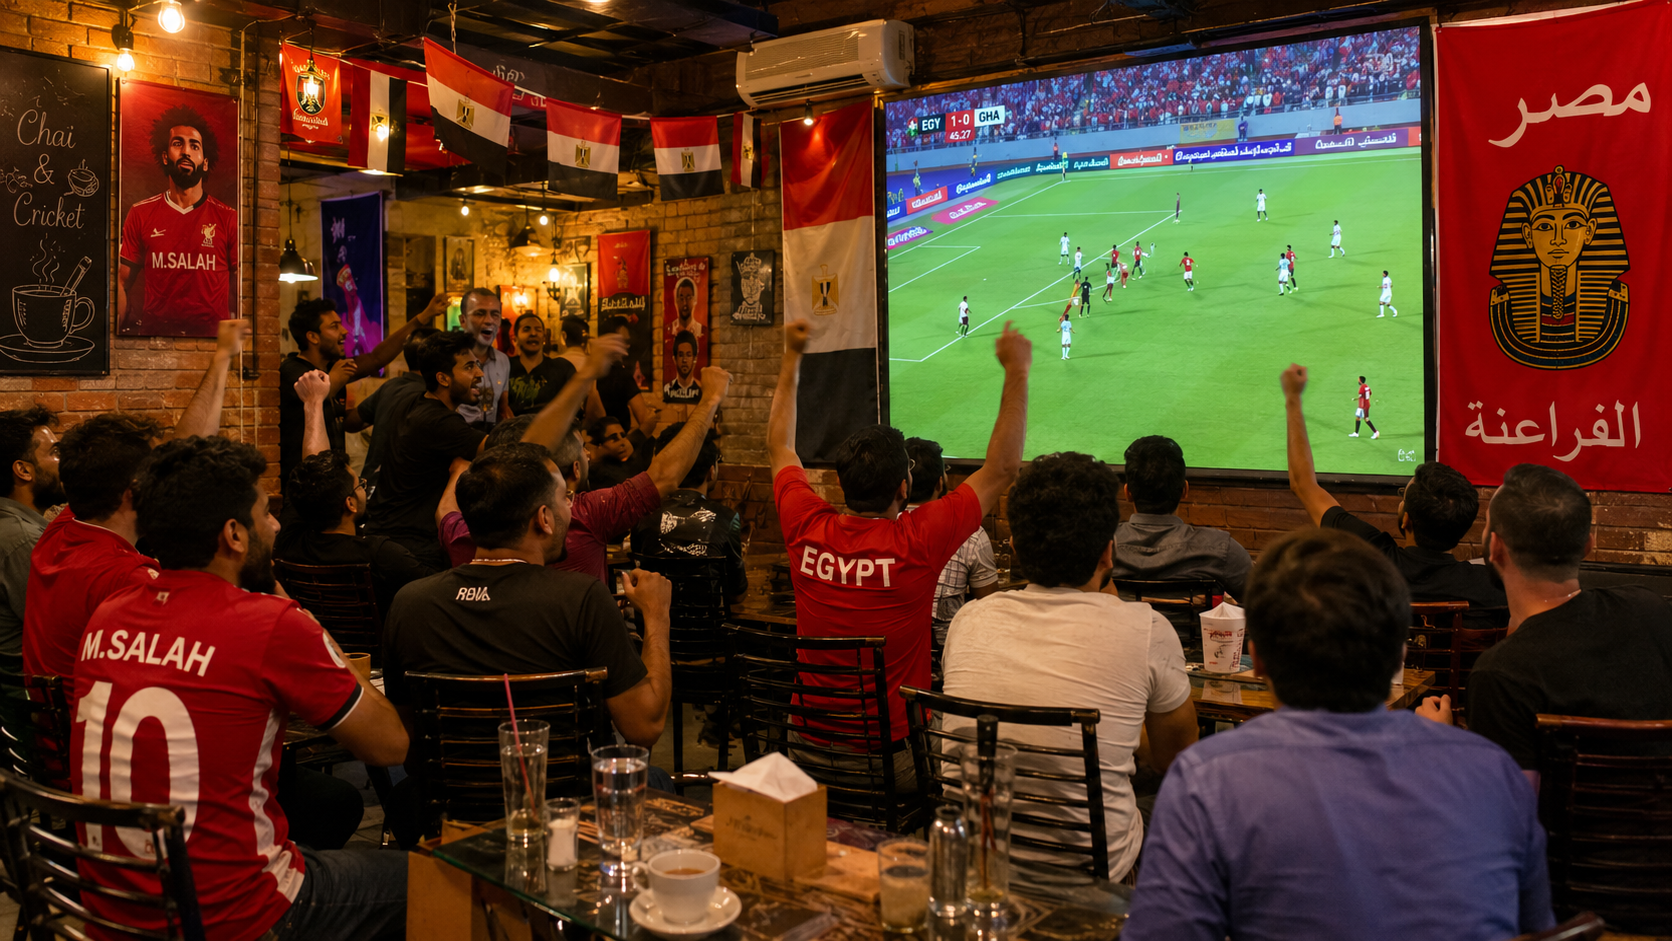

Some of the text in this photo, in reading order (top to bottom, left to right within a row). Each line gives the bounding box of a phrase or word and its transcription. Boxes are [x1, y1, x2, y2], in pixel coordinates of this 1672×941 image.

[17, 109, 77, 149] Chai
[921, 117, 941, 131] EGY
[978, 110, 1000, 123] GHA
[1488, 82, 1652, 148] مصر
[34, 153, 55, 184] &
[13, 191, 86, 229] Cricket
[152, 251, 216, 271] M.SALAH
[1465, 400, 1641, 462] الفراعنة
[800, 545, 896, 588] EGYPT
[80, 629, 216, 677] M.SALAH
[75, 680, 200, 861] 10
